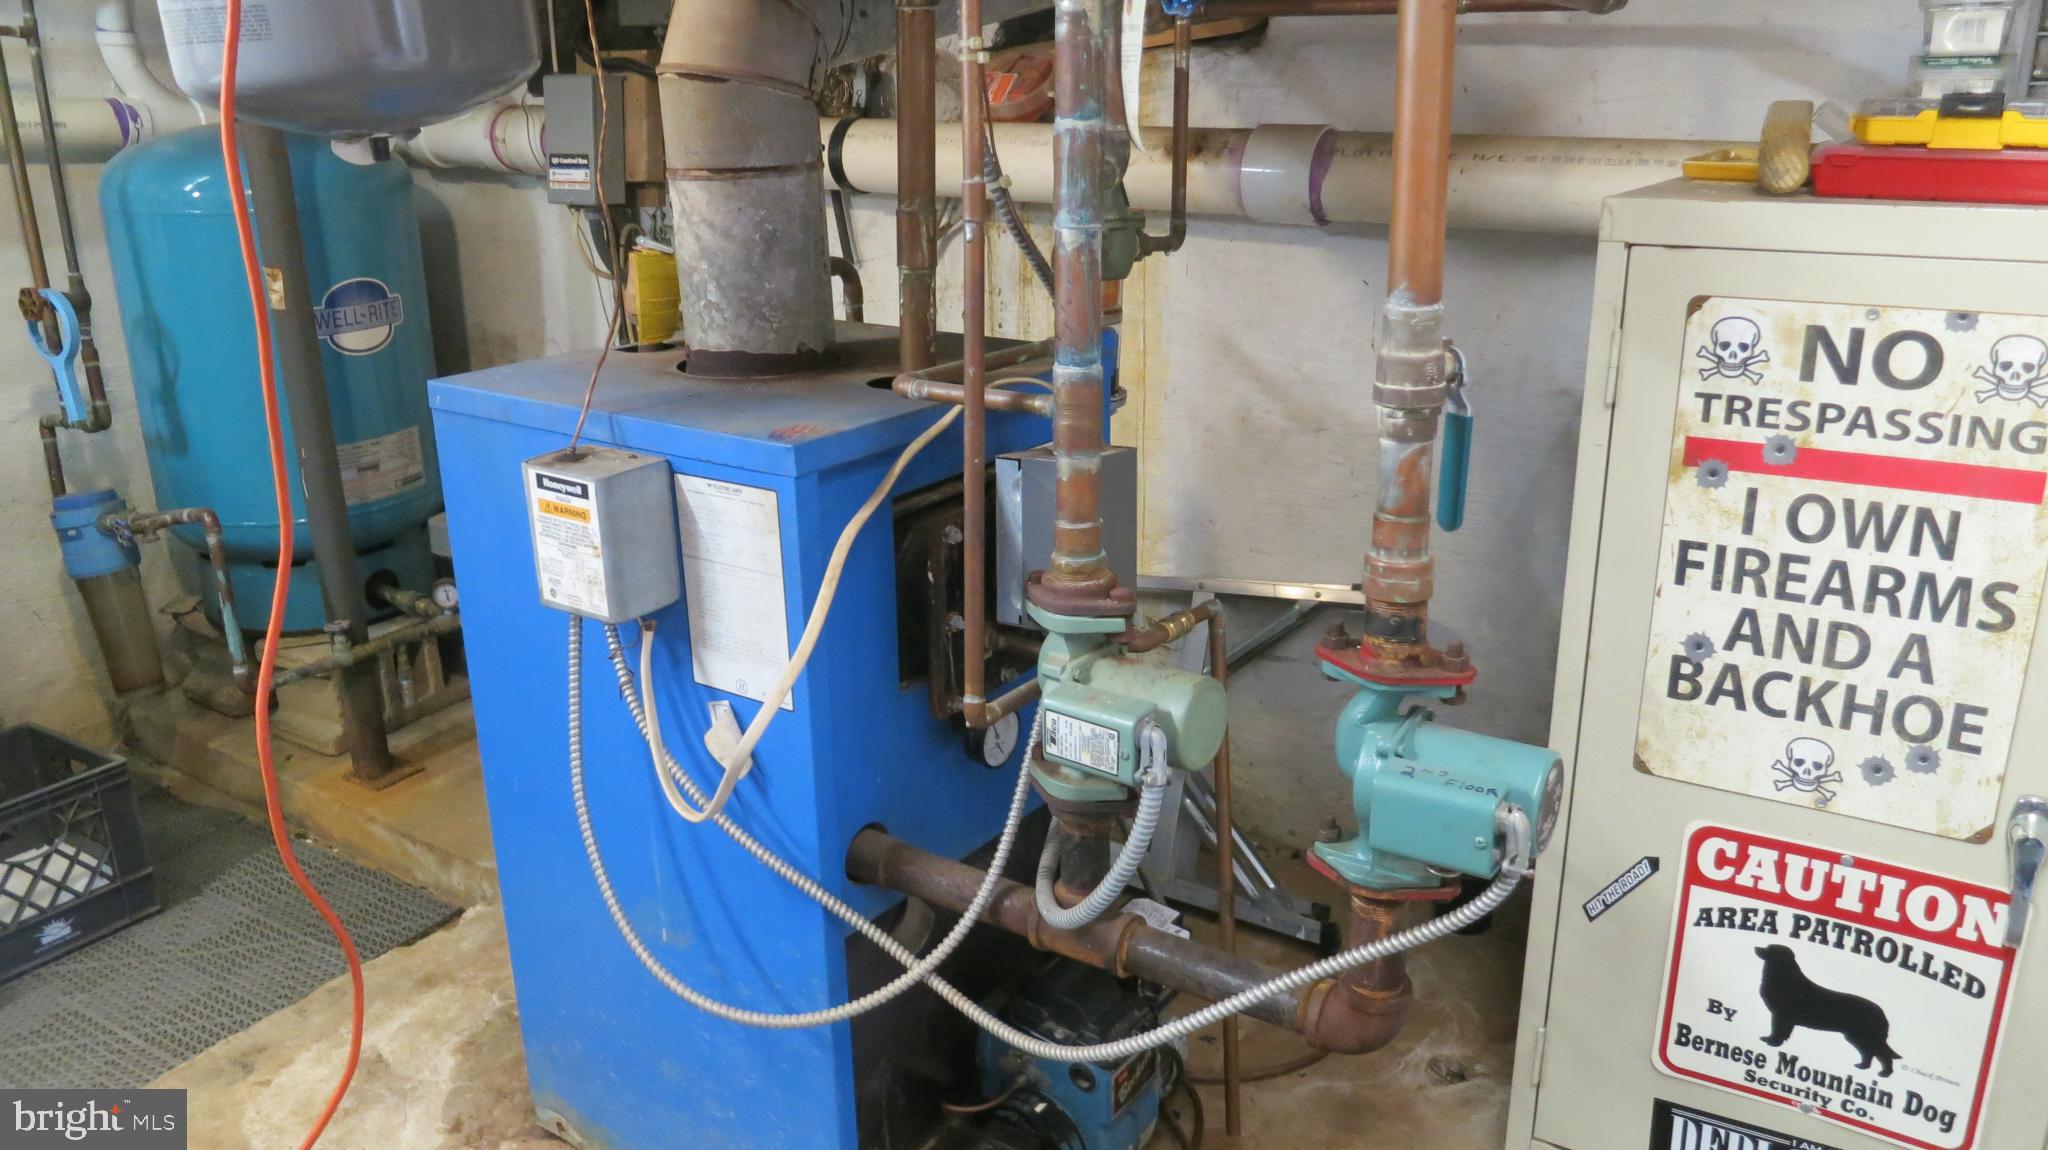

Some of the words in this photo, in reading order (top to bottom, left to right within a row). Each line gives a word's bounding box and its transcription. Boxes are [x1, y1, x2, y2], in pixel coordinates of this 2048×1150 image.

[314, 298, 400, 330] WELL-RITE
[1799, 324, 1944, 391] NO
[1694, 391, 2048, 455] TRESPASSING
[542, 477, 583, 495] Honeywell
[552, 502, 588, 521] WARNING
[1741, 486, 1759, 536] I
[1785, 493, 1962, 562] OWN
[1673, 539, 2020, 634] FIREARMS
[1721, 607, 1872, 671] AND
[1886, 633, 1935, 685] A
[1666, 653, 1989, 755] BACKHOE
[1586, 896, 1605, 916] HIT
[1601, 883, 1623, 904] THE
[1618, 859, 1651, 891] ROAD!
[1697, 837, 2012, 948] CAUTION
[1693, 907, 1778, 935] AREA
[1789, 912, 1987, 1000] PATROLLED
[1706, 998, 1738, 1022] By
[1674, 1022, 1768, 1069] Bernese
[1775, 1050, 1894, 1110] Mountain
[1902, 1090, 1957, 1134] Dog
[1743, 1069, 1832, 1109] Security
[1840, 1099, 1875, 1121] Co.
